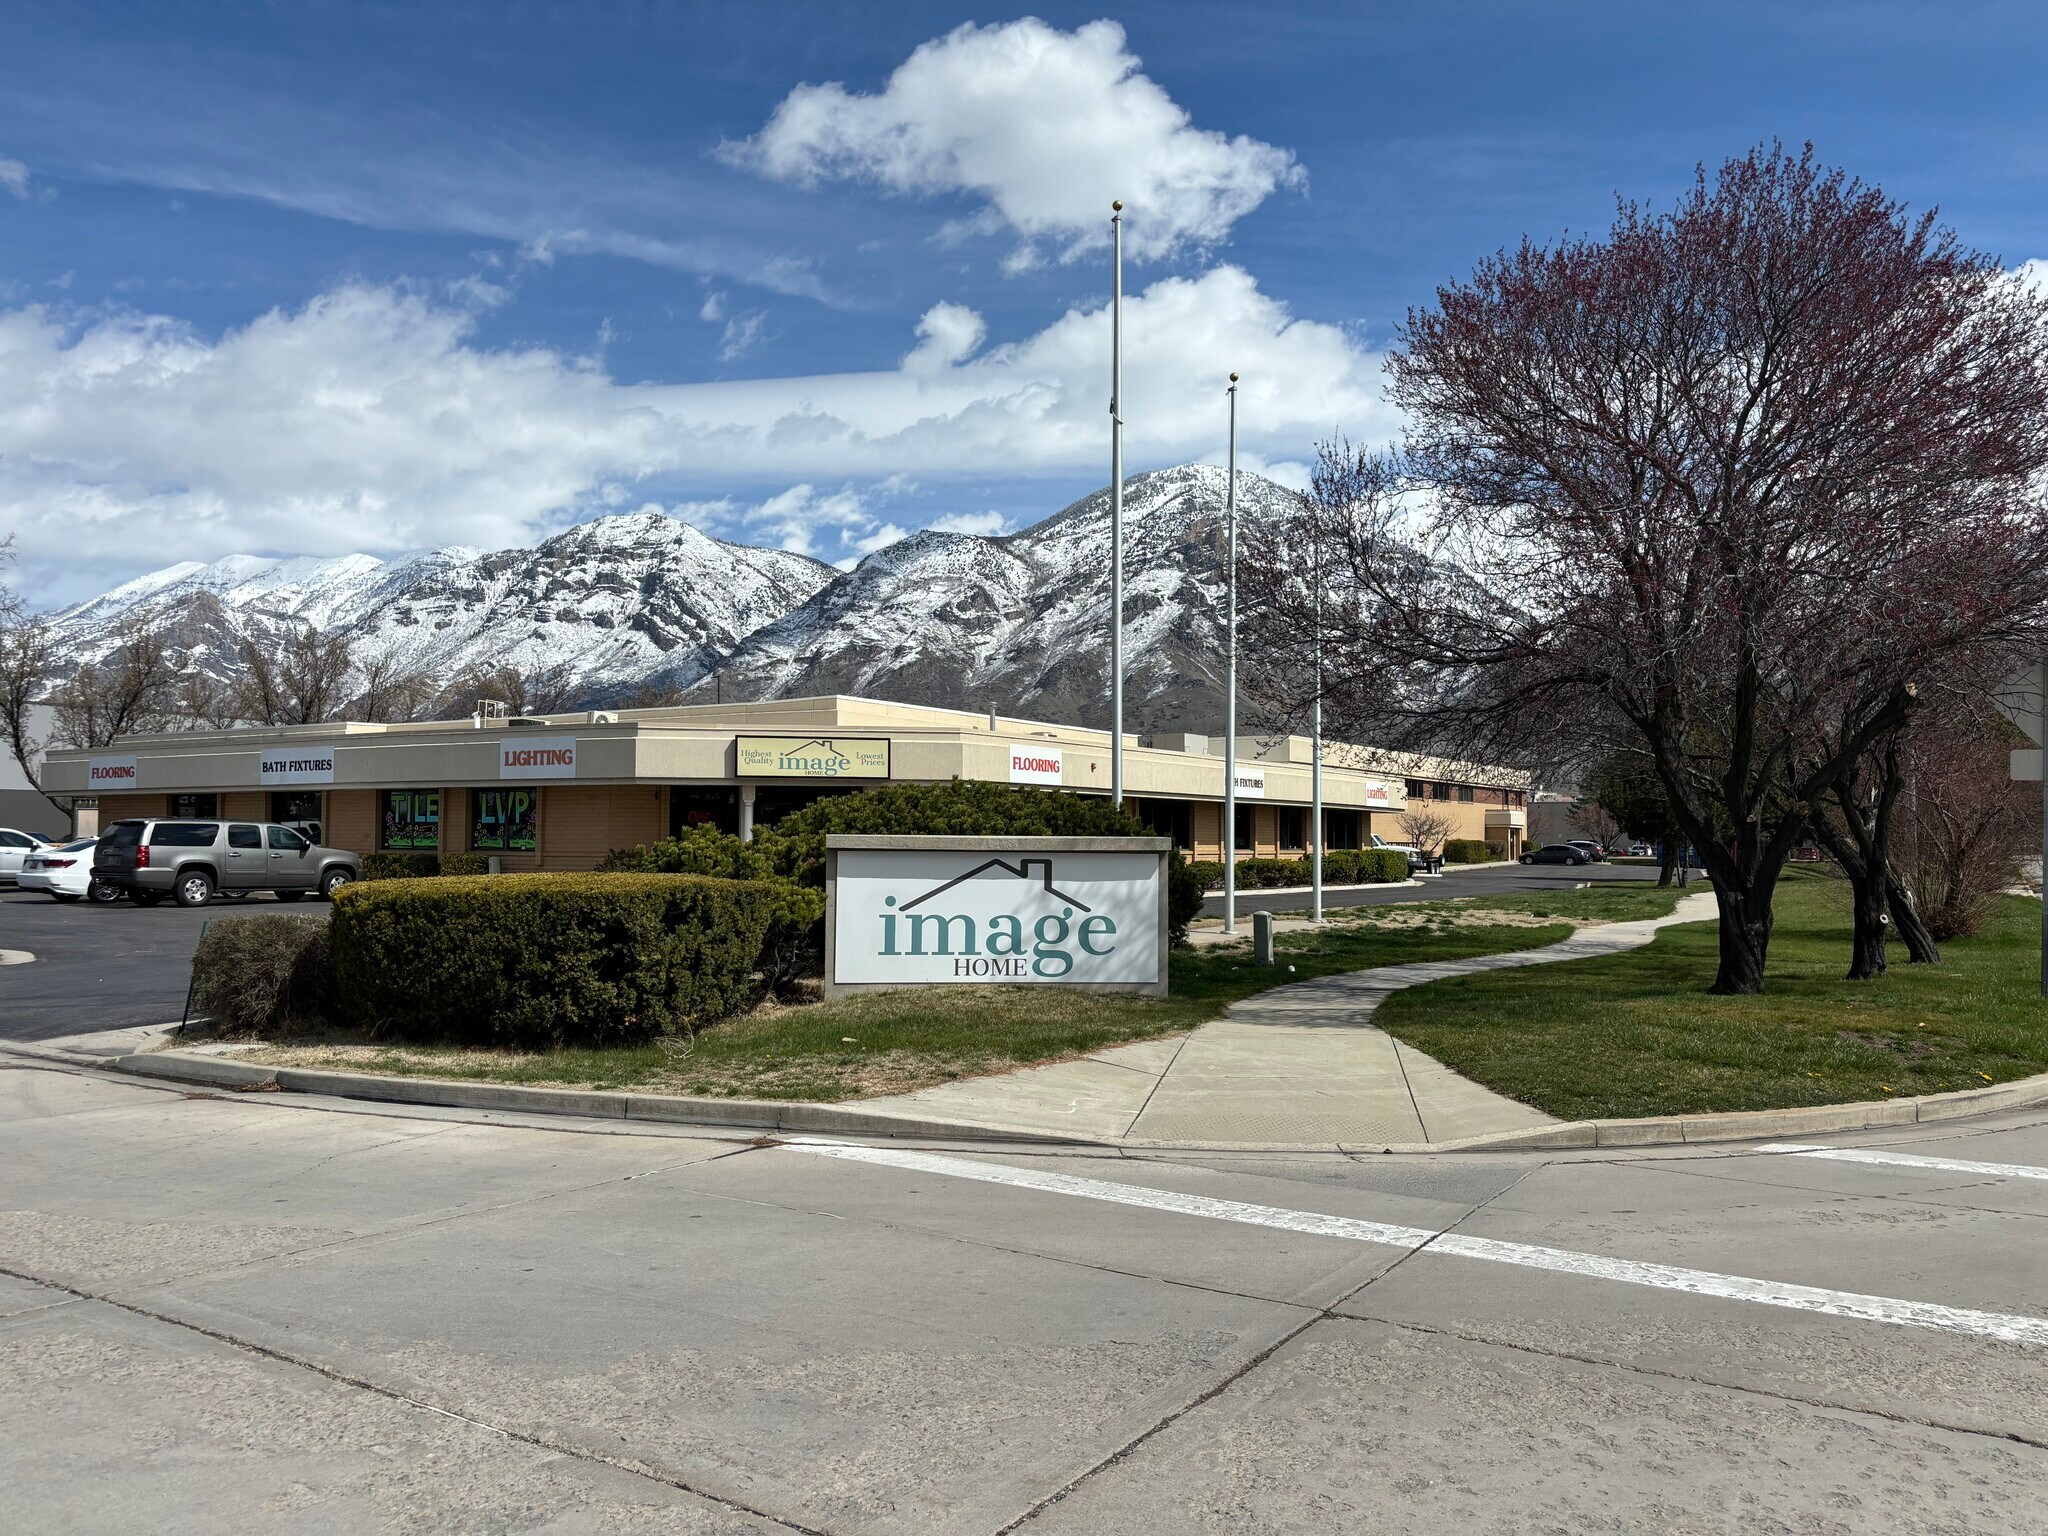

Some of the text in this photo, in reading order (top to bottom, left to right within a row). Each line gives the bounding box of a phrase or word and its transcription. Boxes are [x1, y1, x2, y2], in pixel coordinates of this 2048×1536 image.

[504, 749, 573, 767] LIGHTING
[741, 750, 772, 759] Highest
[744, 756, 774, 766] Quality
[856, 752, 884, 760] Lowest
[262, 759, 332, 773] BATH FIXTURES
[778, 752, 851, 776] image
[1012, 756, 1060, 773] FLOORING
[91, 766, 135, 779] FLOORING
[1240, 778, 1263, 788] FIXTURES
[1367, 789, 1388, 800] LIGHTING
[391, 794, 439, 823] TILE
[481, 791, 530, 824] LVP
[878, 895, 1117, 978] image
[953, 958, 1028, 977] HOME
